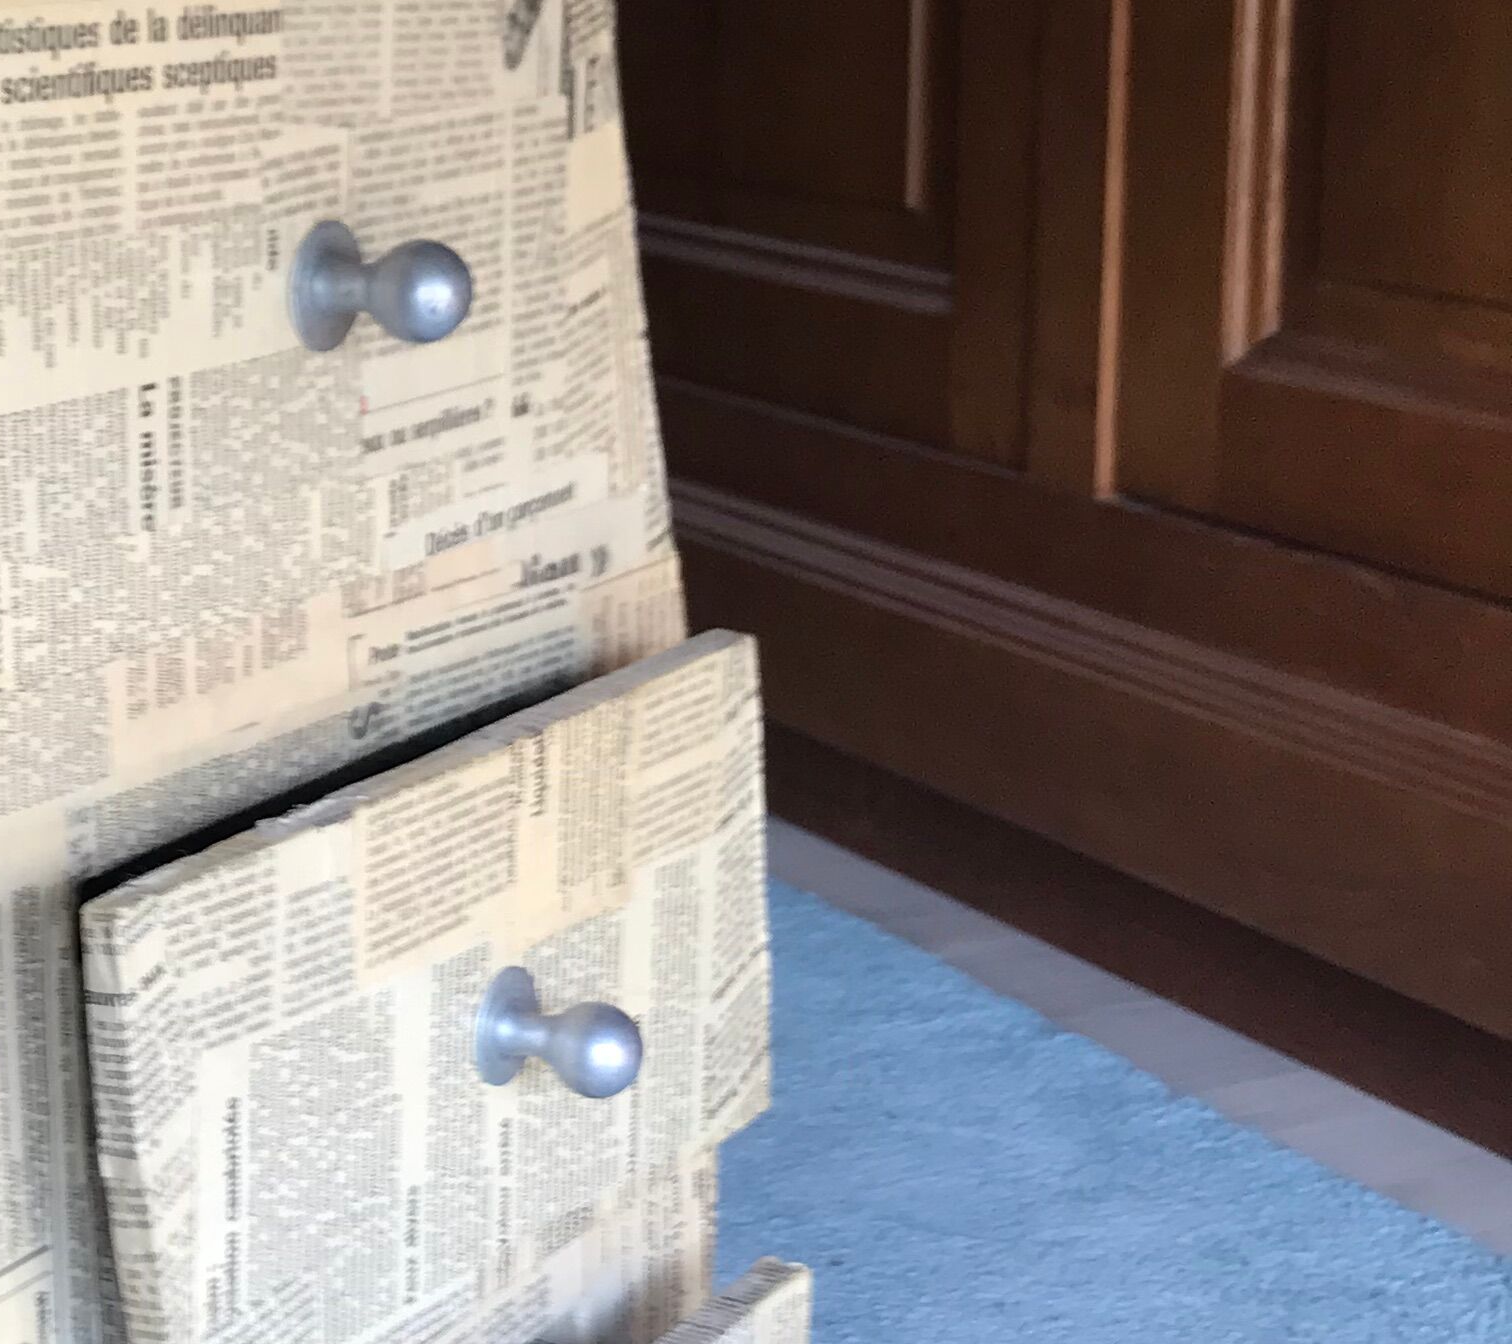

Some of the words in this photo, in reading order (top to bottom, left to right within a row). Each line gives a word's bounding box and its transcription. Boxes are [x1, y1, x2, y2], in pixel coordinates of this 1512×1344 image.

[109, 9, 139, 45] de
[146, 6, 170, 43] la
[0, 61, 154, 105] scientifiques
[161, 49, 278, 95] sceptiques
